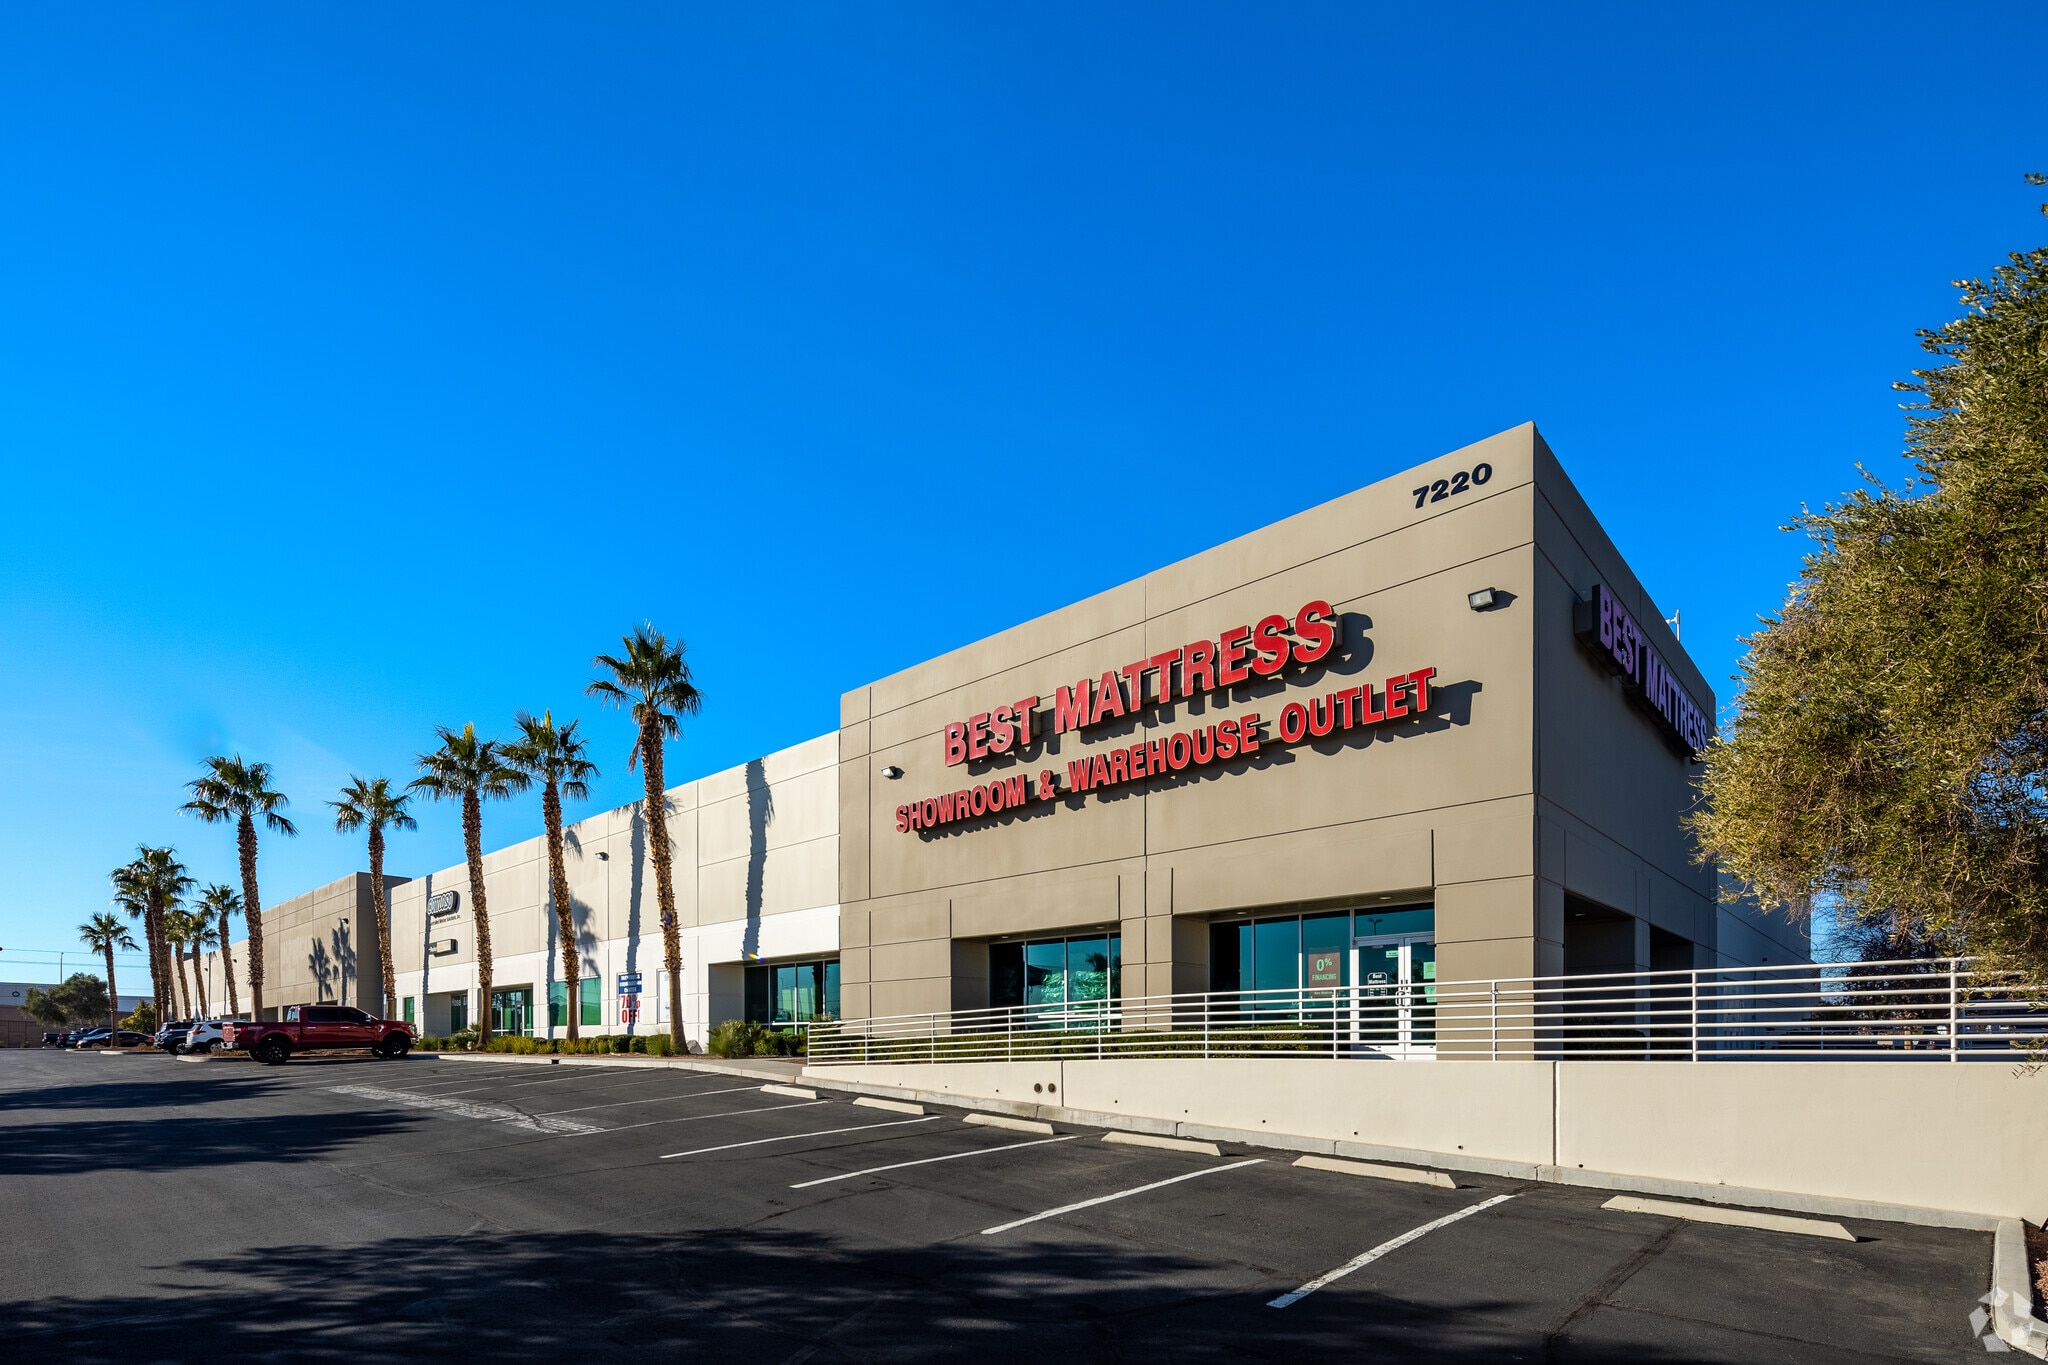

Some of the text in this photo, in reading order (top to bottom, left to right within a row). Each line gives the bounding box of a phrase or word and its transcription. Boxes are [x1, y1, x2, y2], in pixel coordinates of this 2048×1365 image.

[1413, 463, 1492, 509] 7220
[944, 599, 1335, 767] BEST MATTRESS
[1599, 584, 1708, 752] BEST MATTRESS
[896, 667, 1436, 833] SHOWROOM & WAREHOUSE OUTLET
[1316, 958, 1332, 971] 0%
[620, 994, 641, 1009] 70%
[622, 1009, 640, 1023] OFF!
